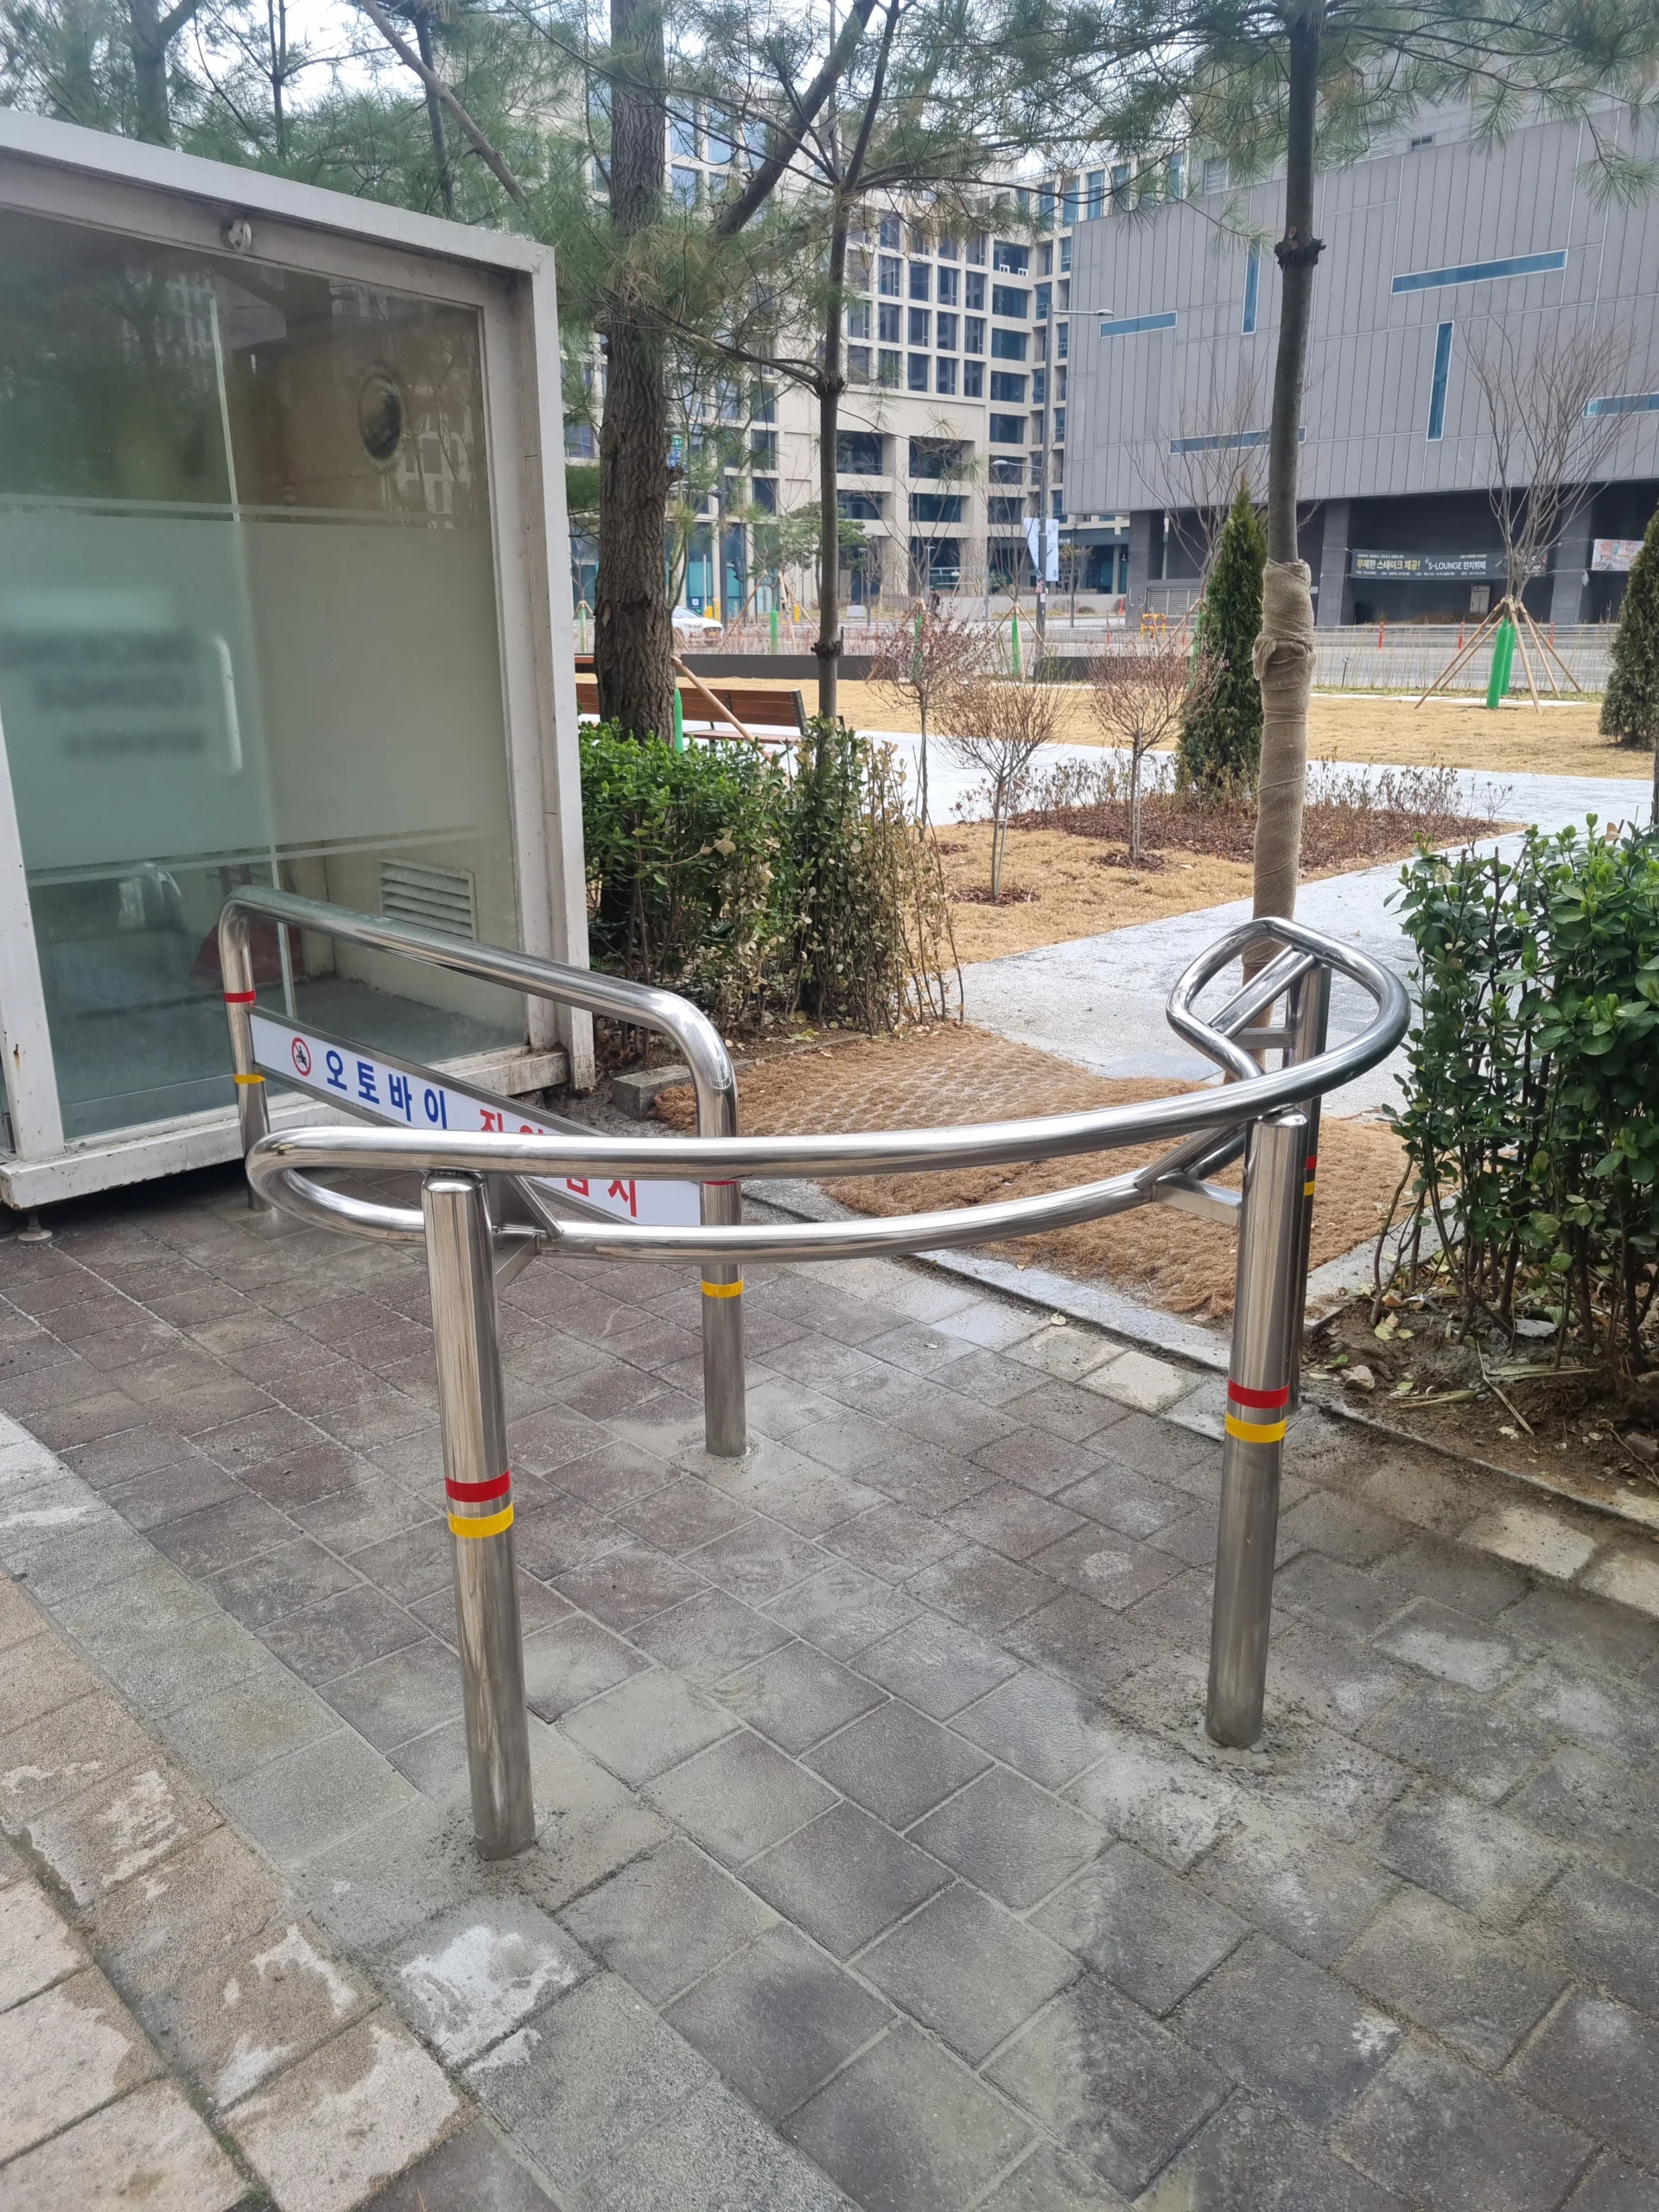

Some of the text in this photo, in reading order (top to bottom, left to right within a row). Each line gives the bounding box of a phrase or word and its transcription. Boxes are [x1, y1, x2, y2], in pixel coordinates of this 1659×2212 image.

[1357, 559, 1376, 569] 무제한
[1376, 559, 1403, 569] 스테이크
[1404, 560, 1421, 570] 제공!
[1428, 561, 1462, 570] S-LOUNGE
[326, 1050, 448, 1130] 오토바이
